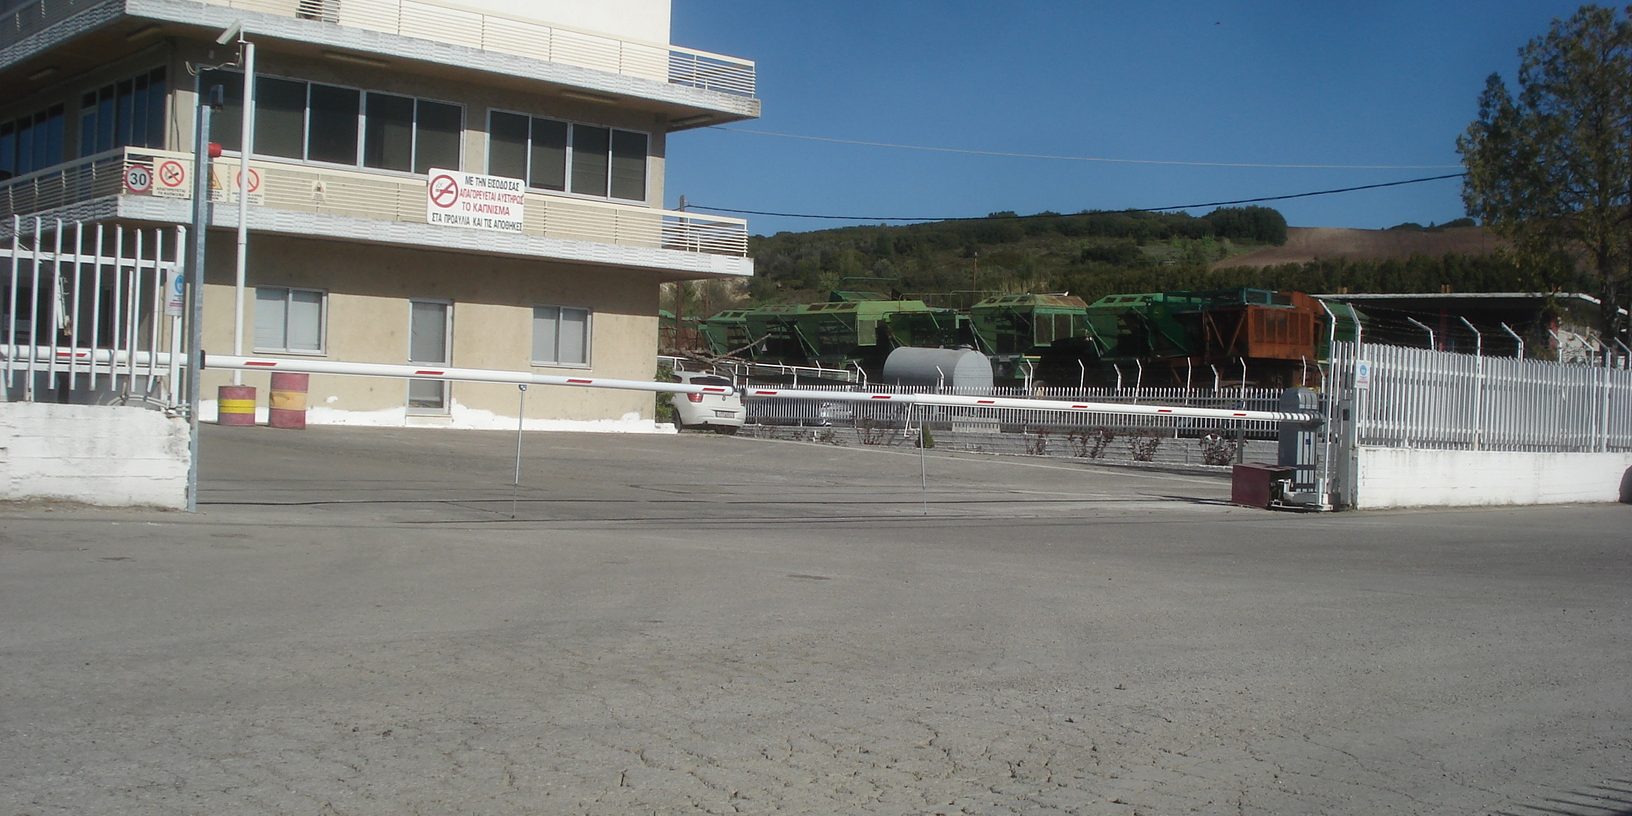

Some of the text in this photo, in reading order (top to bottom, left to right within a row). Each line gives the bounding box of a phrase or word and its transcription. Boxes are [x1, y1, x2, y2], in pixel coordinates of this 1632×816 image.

[130, 173, 147, 186] 30
[465, 176, 474, 186] ΜΕ
[475, 177, 487, 188] ΤΗΝ
[508, 181, 520, 192] ΣΑΣ
[460, 188, 497, 201] ΑΠΑΓΟΡΕΥΕΤΑΙ
[462, 201, 510, 216] ΤΟ ΚΑΠΝΙΣΜΑ
[473, 217, 483, 227] ΚΑΙ
[484, 218, 493, 229] ΤΙΣ
[494, 221, 523, 231] ΑΠΟΘΗΚΕΣ
